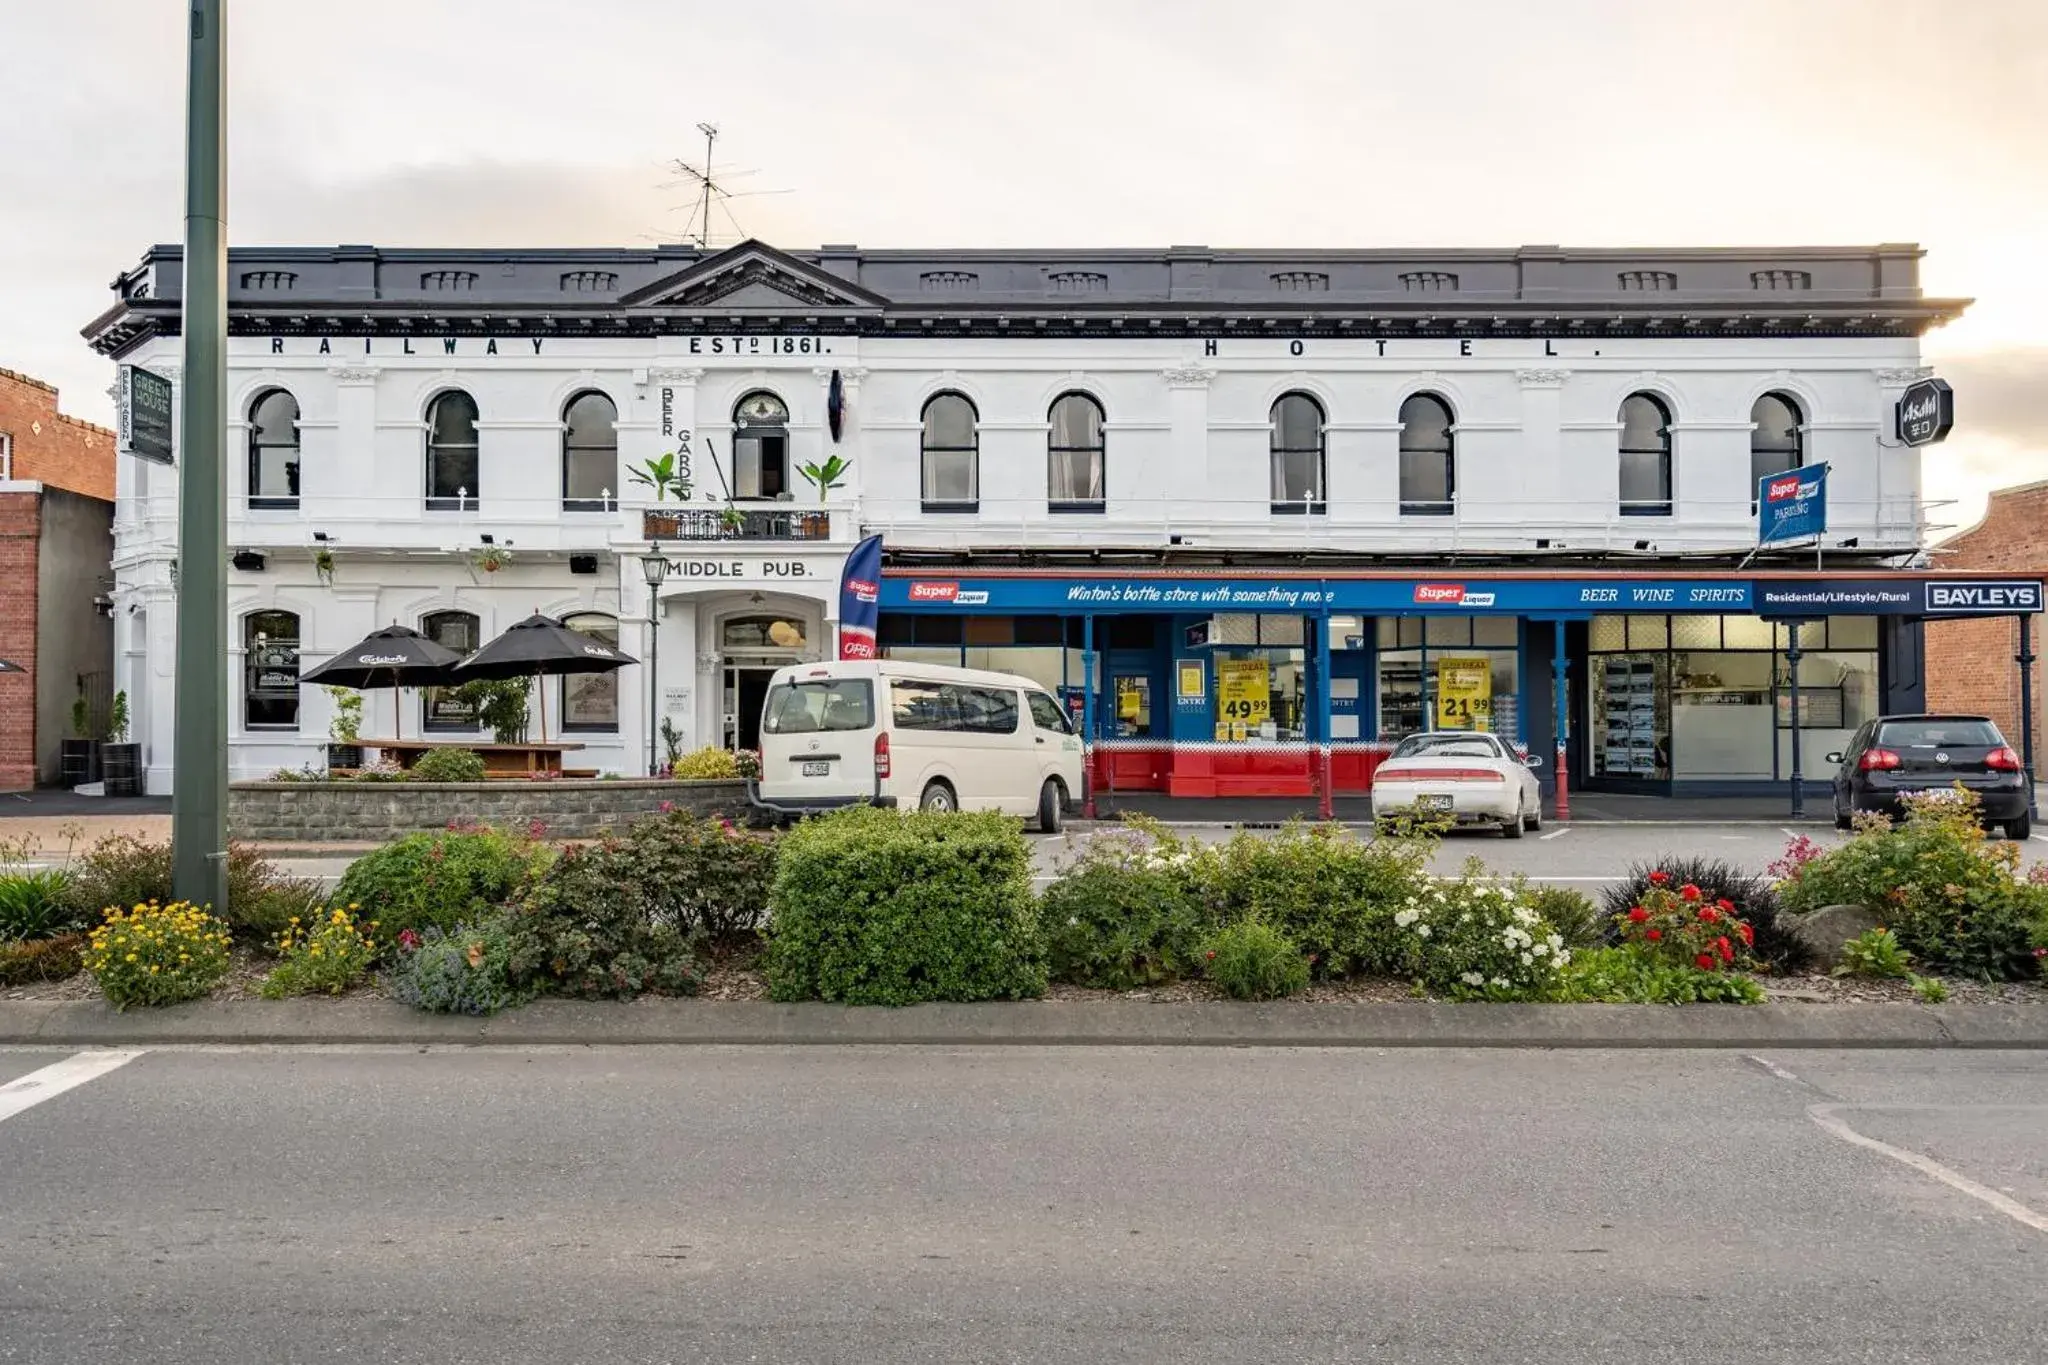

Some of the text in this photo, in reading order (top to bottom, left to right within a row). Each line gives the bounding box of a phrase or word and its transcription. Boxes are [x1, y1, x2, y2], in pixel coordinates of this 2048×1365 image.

[271, 337, 543, 354] RAILWAY
[1205, 339, 1601, 356] HOTEL.
[135, 373, 169, 399] GREEN
[135, 388, 169, 415] HOUSE
[1903, 395, 1937, 424] Asahi
[661, 388, 674, 436] BEER
[1770, 482, 1798, 498] Super
[1774, 502, 1809, 520] PARKING
[667, 562, 813, 576] MIDDLE PUB.
[850, 580, 876, 592] Super
[913, 584, 955, 598] Super
[1419, 586, 1461, 600] Super
[1067, 584, 1334, 607] Winton's bottle store with something moe
[1580, 588, 1745, 602] BEER WINE SPIRITS
[1932, 587, 2035, 605] BAYLEYS
[844, 642, 875, 658] OPEN
[1177, 697, 1206, 705] ENTRY
[1331, 699, 1355, 707] NTRY
